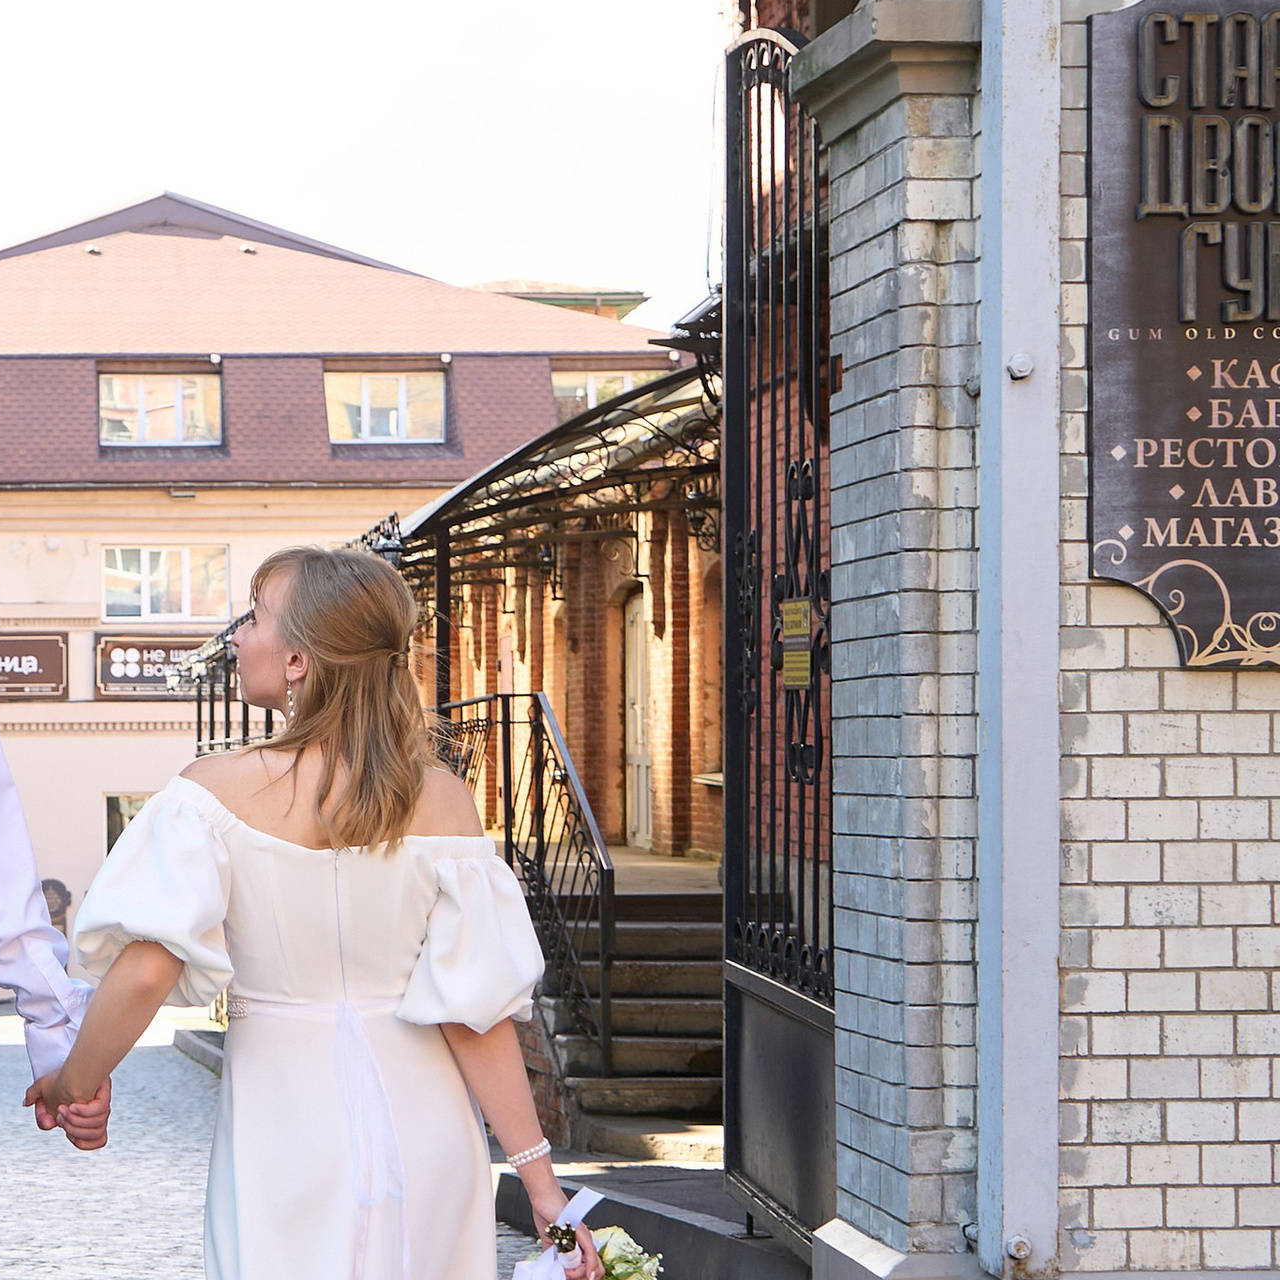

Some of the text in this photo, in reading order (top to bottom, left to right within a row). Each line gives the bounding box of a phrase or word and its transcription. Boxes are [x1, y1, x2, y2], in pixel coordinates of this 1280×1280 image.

[1137, 114, 1280, 220] ДВО
[1108, 328, 1162, 341] GUM
[1185, 327, 1236, 340] OLD
[1133, 437, 1280, 469] РЕСТО
